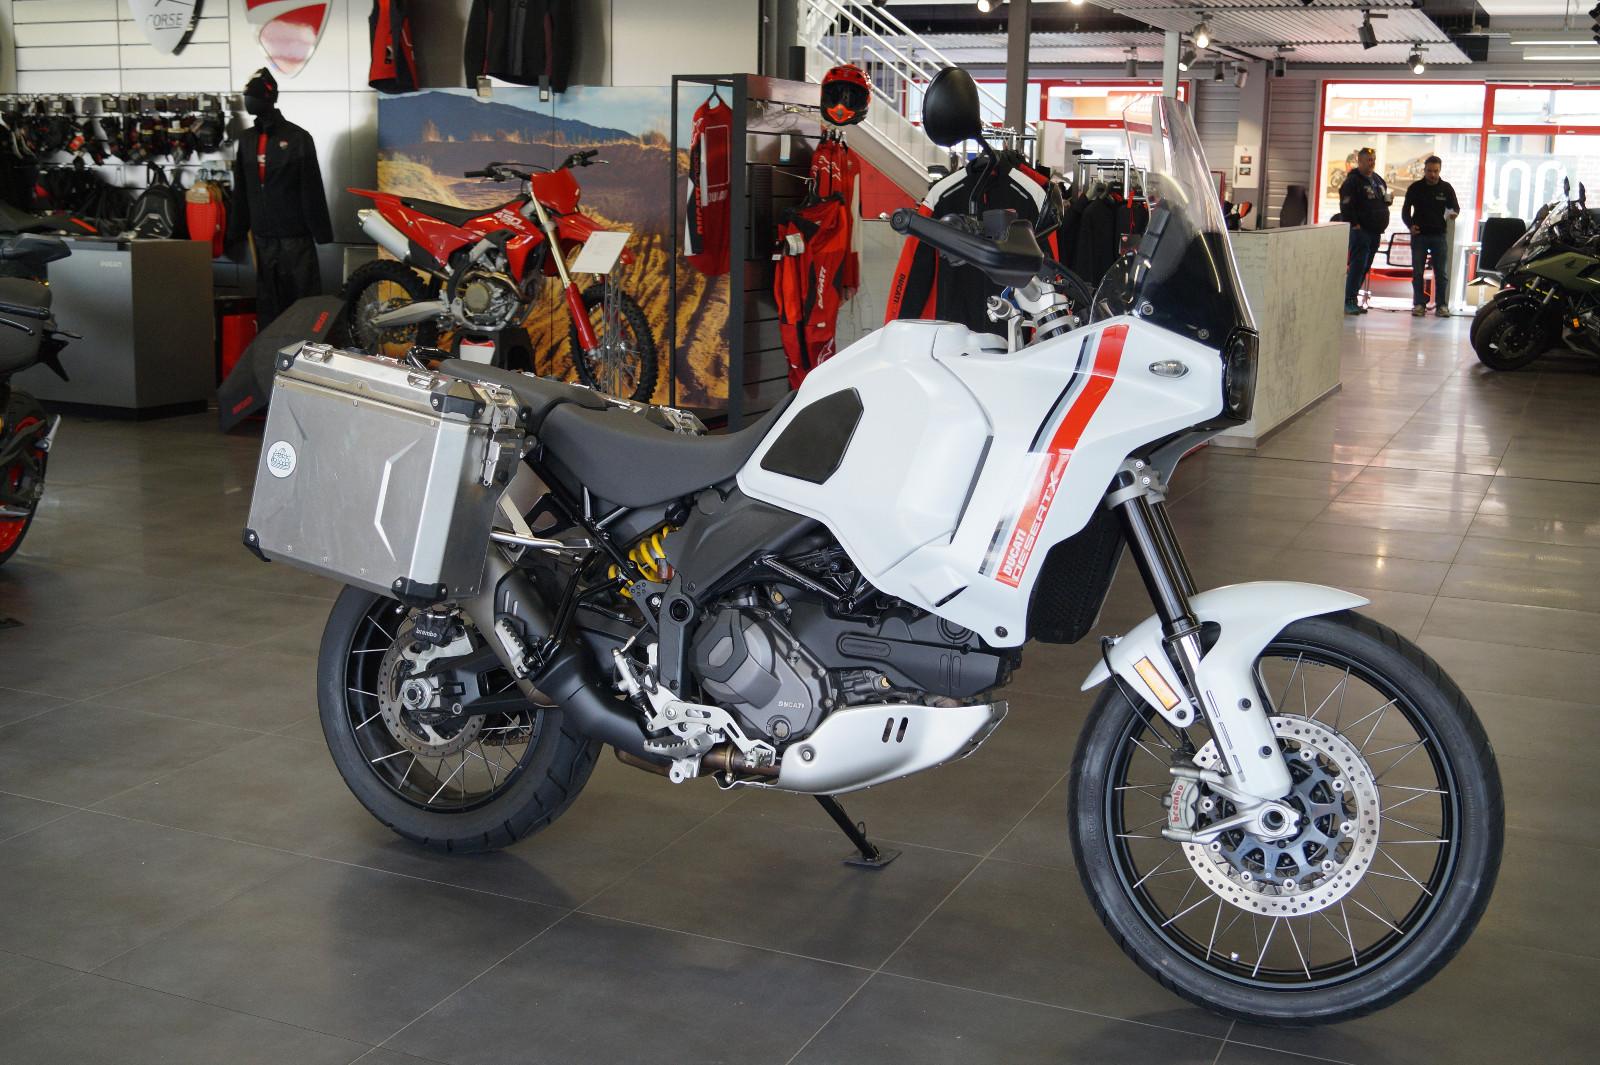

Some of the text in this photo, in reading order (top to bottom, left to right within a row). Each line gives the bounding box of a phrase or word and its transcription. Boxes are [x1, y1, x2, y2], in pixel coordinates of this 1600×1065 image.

[893, 272, 905, 304] DUCATI
[1003, 528, 1027, 577] DUCATI
[416, 627, 438, 638] brembo
[778, 700, 805, 709] DUCATI
[1172, 784, 1184, 823] brembo
